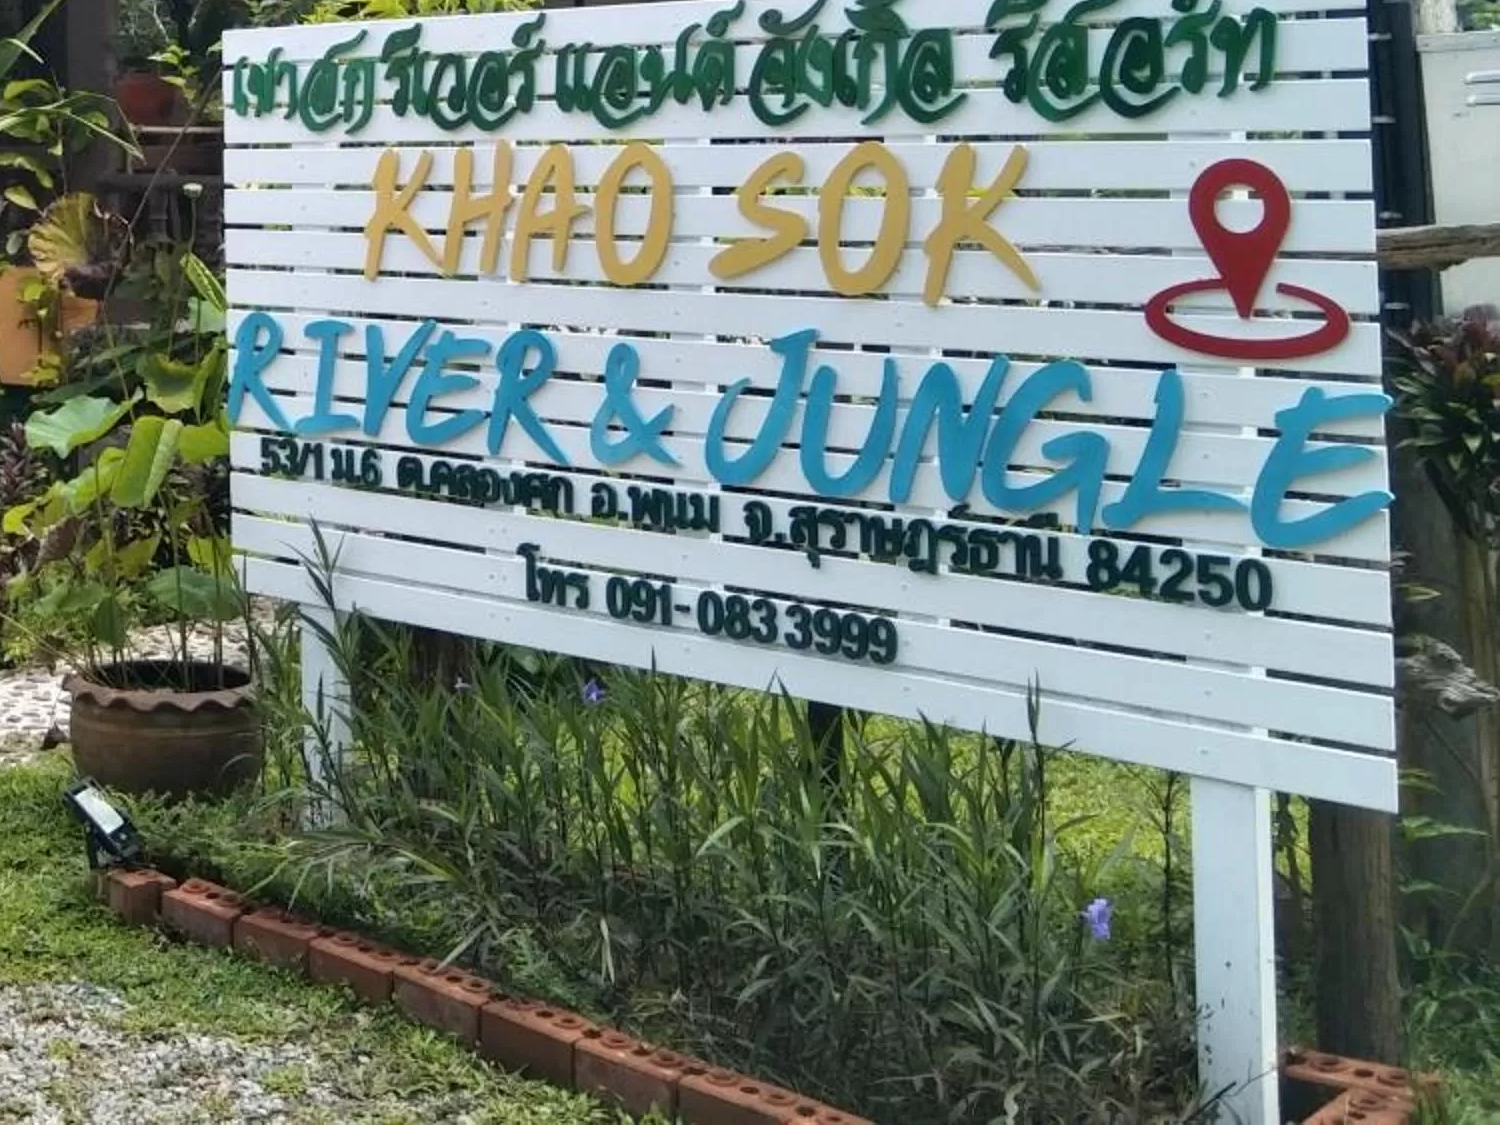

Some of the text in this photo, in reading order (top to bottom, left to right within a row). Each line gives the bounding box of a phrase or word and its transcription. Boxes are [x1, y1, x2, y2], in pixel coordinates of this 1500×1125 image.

[381, 12, 547, 131] รีเวอร์
[364, 138, 1043, 307] KHAO SOK
[227, 311, 1395, 549] RIVER & JUNGLE
[516, 542, 590, 610] โทร
[1086, 537, 1274, 613] 84250
